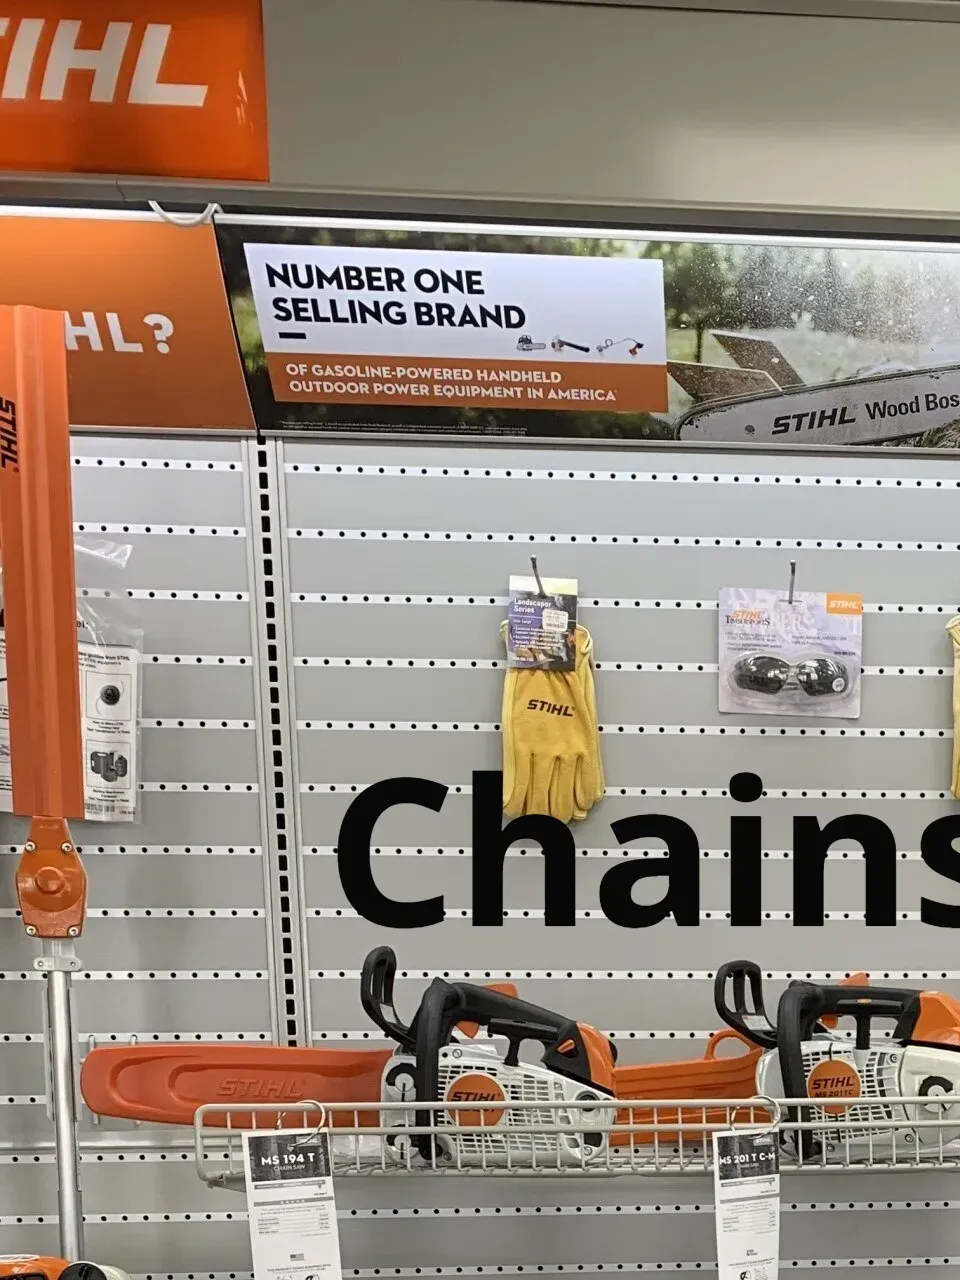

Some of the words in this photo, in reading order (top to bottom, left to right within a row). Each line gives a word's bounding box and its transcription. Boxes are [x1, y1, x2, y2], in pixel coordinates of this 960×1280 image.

[0, 17, 208, 107] IHL
[266, 263, 407, 293] NUMBER
[414, 268, 485, 295] ONE
[273, 297, 407, 326] SELLING
[416, 302, 527, 330] BRAND
[285, 363, 307, 375] OF
[311, 364, 474, 382] GASOLINE-POWERED
[476, 369, 562, 384] HANDHELD
[289, 380, 371, 395] OUTDOOR
[373, 383, 431, 397] POWER
[432, 385, 523, 400] EQUIPMENT
[526, 387, 544, 400] IN
[771, 406, 856, 436] STIHL
[865, 395, 921, 421] Wood
[513, 606, 534, 614] Series
[829, 600, 858, 609] STIHL
[527, 699, 573, 717] STIHL
[216, 1077, 304, 1098] STIHL
[811, 1077, 855, 1090] STIHL
[261, 1155, 279, 1165] MS
[283, 1153, 304, 1164] 194
[307, 1152, 315, 1162] T
[720, 1155, 731, 1165] MS
[734, 1154, 749, 1163] 201
[751, 1153, 757, 1161] T
[759, 1152, 776, 1160] C-M
